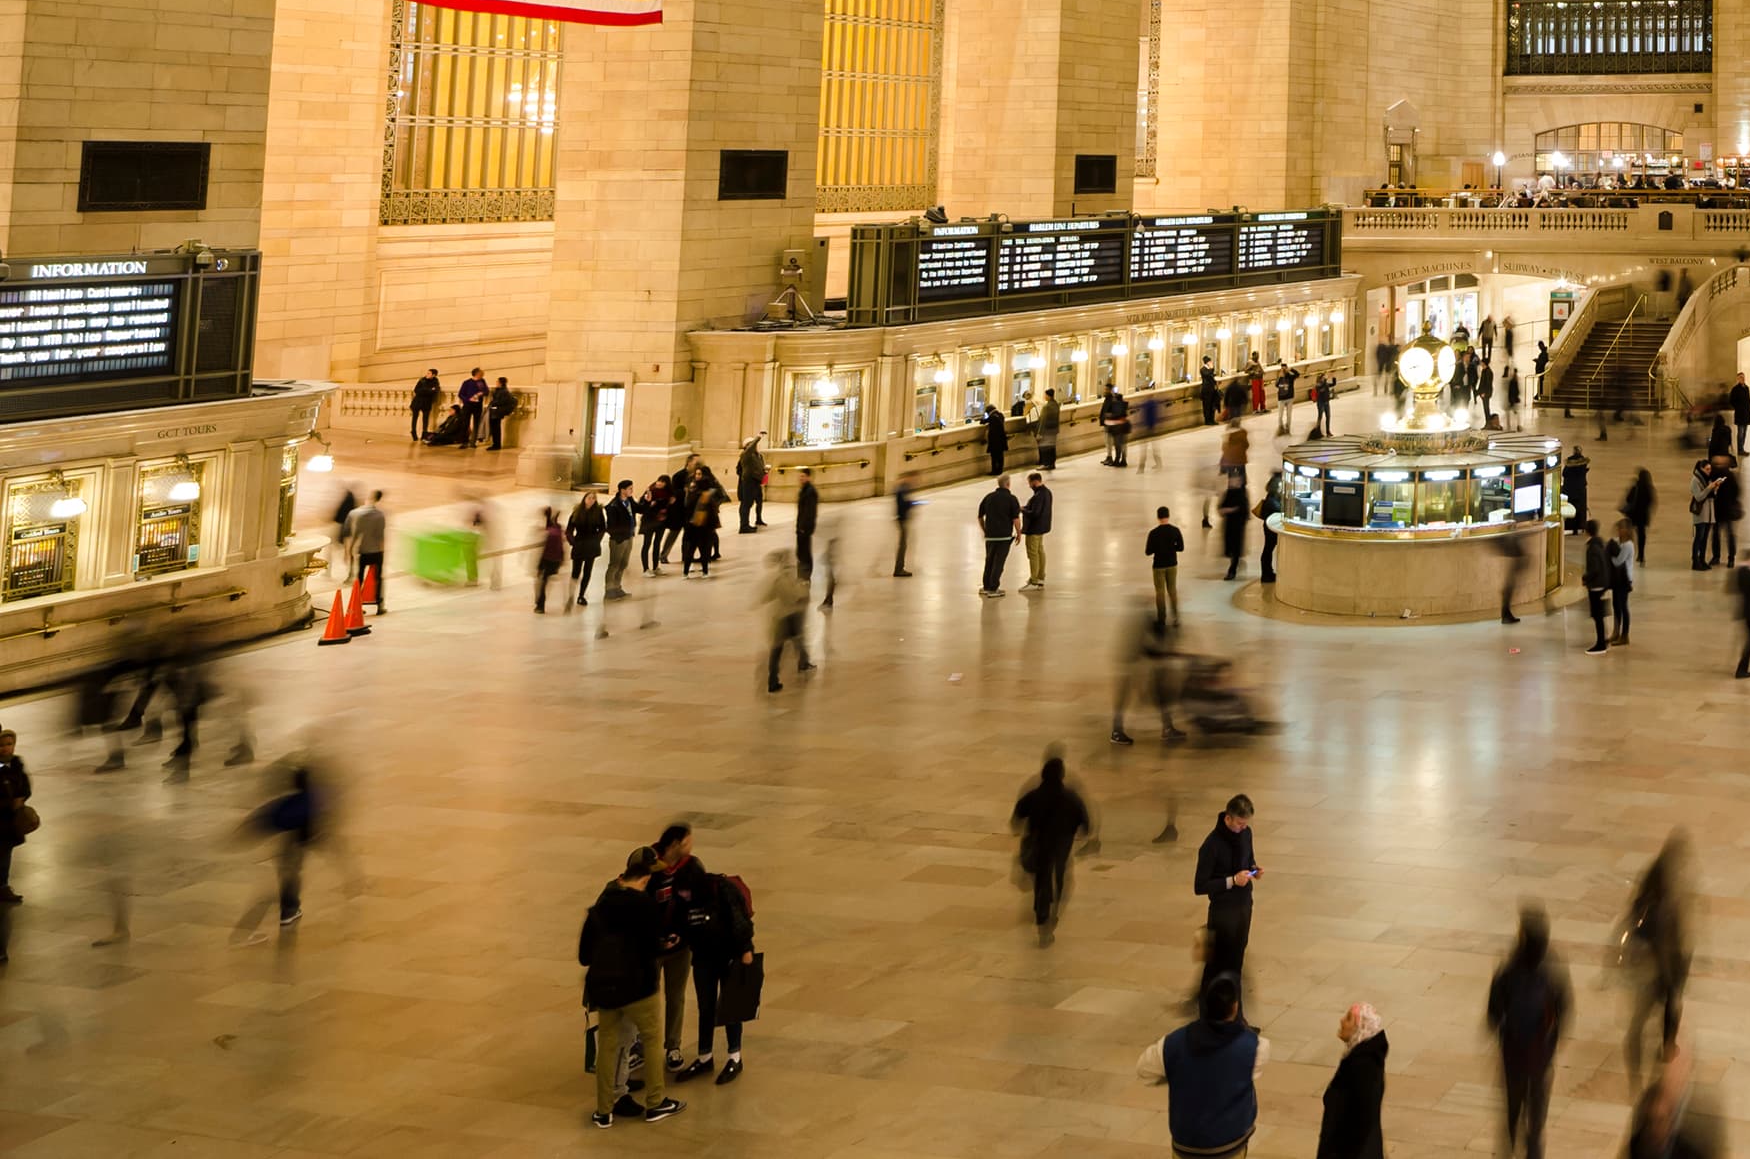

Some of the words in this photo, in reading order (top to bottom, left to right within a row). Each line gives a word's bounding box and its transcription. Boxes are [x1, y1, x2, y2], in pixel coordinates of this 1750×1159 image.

[934, 225, 978, 236] INFORMATION
[1503, 262, 1540, 274] SUBWAY
[1648, 256, 1668, 265] WEST
[1669, 256, 1704, 266] BALCONY
[32, 261, 147, 278] INFORMATION
[1383, 265, 1419, 282] TICKET
[1421, 261, 1473, 275] MACHINES
[30, 289, 83, 301] Attention
[0, 307, 24, 318] ever
[29, 305, 59, 316] leave
[63, 302, 109, 316] packages
[113, 298, 169, 312] unattended
[0, 320, 52, 333] nattended
[57, 318, 86, 330] items
[90, 317, 108, 328] may
[112, 316, 125, 327] be
[129, 313, 168, 325] removed
[1, 338, 16, 350] By
[21, 336, 39, 346] the
[43, 334, 62, 345] MTA
[66, 331, 102, 343] Police
[106, 328, 160, 341] Department
[30, 351, 50, 362] you
[55, 349, 73, 360] for
[77, 347, 101, 359] your
[104, 343, 166, 356] cooperation
[157, 428, 179, 439] GCT
[182, 423, 217, 437] TOURS
[43, 527, 60, 537] Tours
